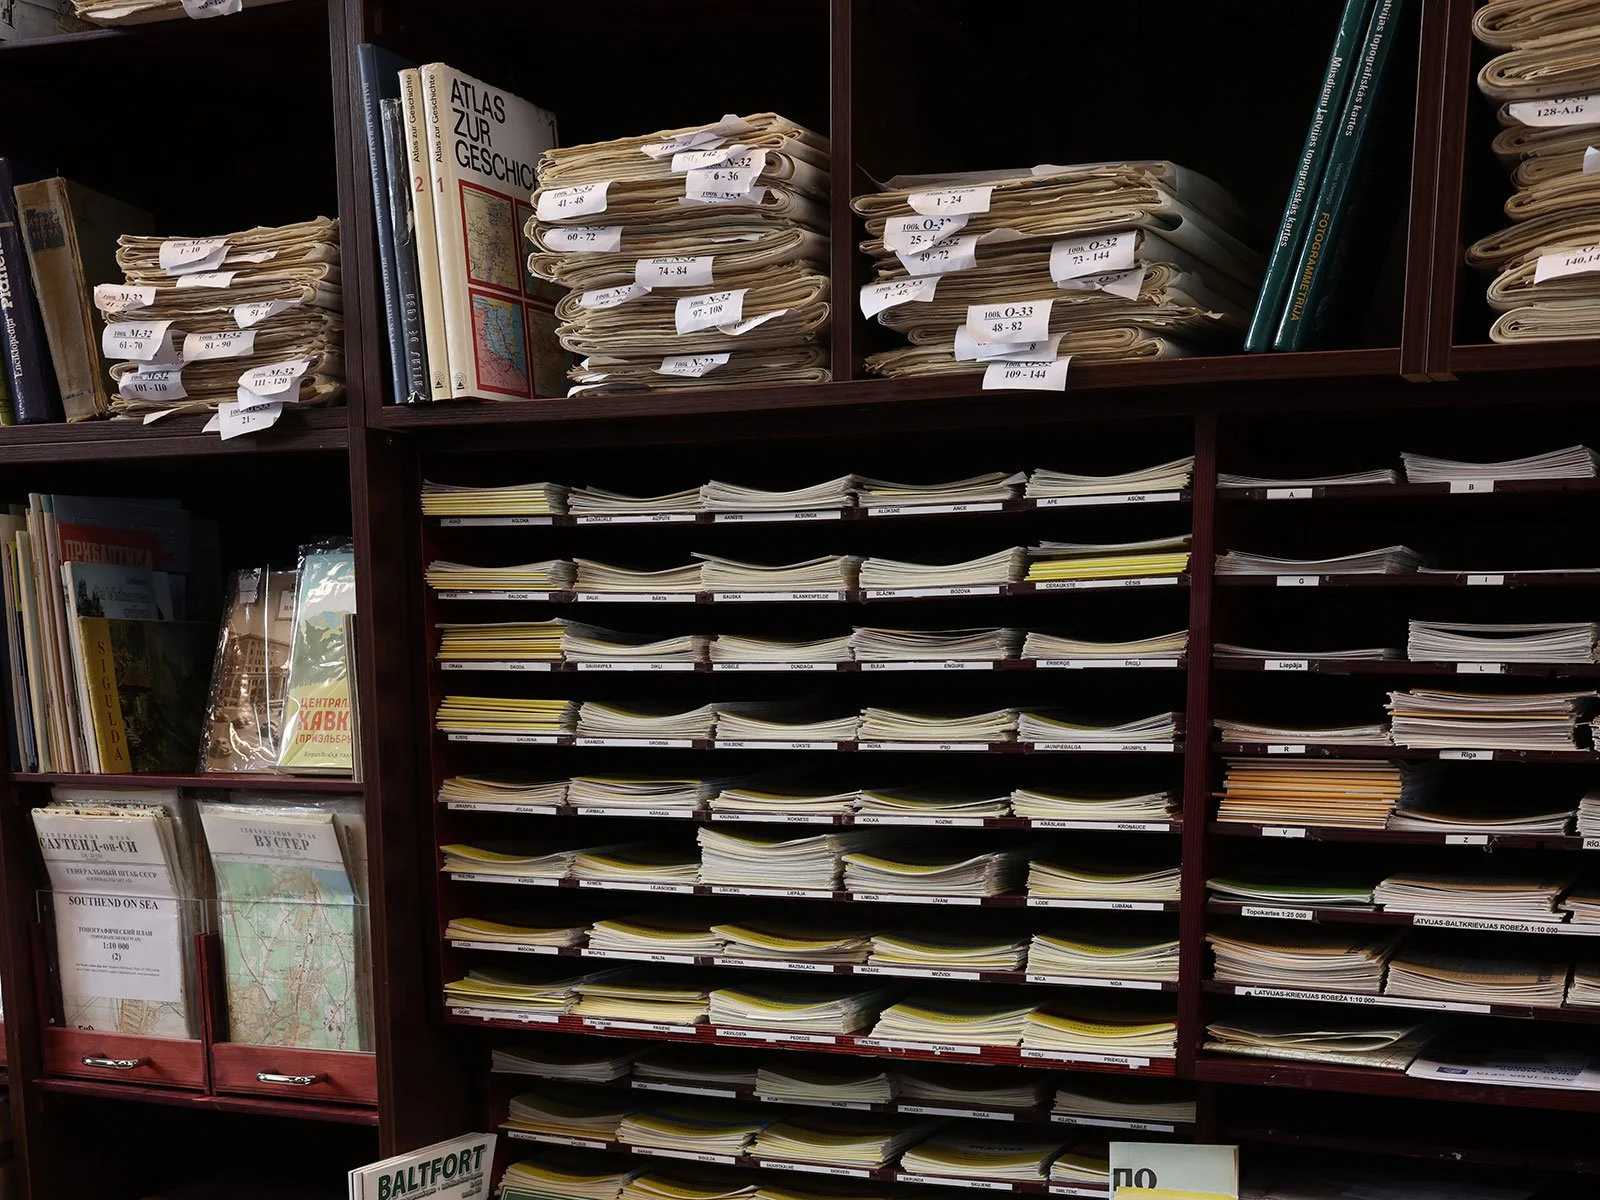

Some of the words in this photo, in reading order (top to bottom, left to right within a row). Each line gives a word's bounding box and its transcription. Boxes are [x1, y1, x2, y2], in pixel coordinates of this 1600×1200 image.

[406, 74, 416, 119] Geschichte
[429, 74, 439, 119] Geschichte
[451, 77, 506, 124] ATLAS
[1345, 105, 1362, 137] kartes
[453, 108, 492, 148] ZUR
[412, 135, 421, 163] Atlas
[435, 135, 443, 163] Atlas
[726, 157, 751, 167] N-32
[728, 172, 739, 180] 36
[415, 176, 424, 193] 2
[437, 177, 444, 193] 1
[558, 199, 567, 207] 41
[574, 196, 584, 204] 48
[951, 196, 962, 204] 24
[567, 233, 578, 241] 60
[585, 233, 596, 241] 72
[1280, 216, 1296, 247] kartes
[910, 235, 921, 245] 25
[1088, 238, 1118, 251] O-32
[920, 253, 930, 262] 49
[938, 250, 949, 260] 72
[1072, 255, 1084, 265] 73
[1093, 251, 1110, 261] 144
[658, 267, 669, 276] 74
[676, 267, 687, 275] 84
[1290, 212, 1330, 321] FOTOGRAMMETRIJA
[692, 309, 702, 318] 97
[709, 305, 723, 315] 108
[1004, 307, 1033, 317] O-33
[992, 323, 1003, 332] 48
[1011, 321, 1023, 331] 82
[129, 330, 153, 338] M-32
[119, 342, 128, 350] 61
[205, 342, 213, 350] 81
[1004, 370, 1021, 379] 109
[1030, 369, 1046, 378] 144
[274, 377, 288, 385] 120
[134, 384, 147, 392] 101
[155, 384, 168, 392] 110
[242, 416, 250, 424] 21
[1280, 662, 1302, 670] Liepāja
[97, 641, 124, 762] SIGULDA
[301, 698, 350, 709] ЦЕНТРАЛ
[299, 711, 351, 731] КАВК
[296, 732, 352, 744] (ПРИЭЛЬБРУ
[253, 835, 309, 850] ВУСТЕР
[139, 871, 157, 879] СССР
[68, 896, 120, 908] SOUTHEND
[123, 899, 137, 909] ON
[140, 900, 158, 910] SEA
[1246, 908, 1280, 917] Topokartes
[1500, 924, 1529, 932] ROBEŽA
[102, 941, 116, 950] 1:10
[118, 942, 129, 950] 000
[112, 953, 121, 961] (2)
[1254, 989, 1320, 1000] LATVIJAS-KRIEVIJAS
[1321, 993, 1348, 1002] ROBEŽA
